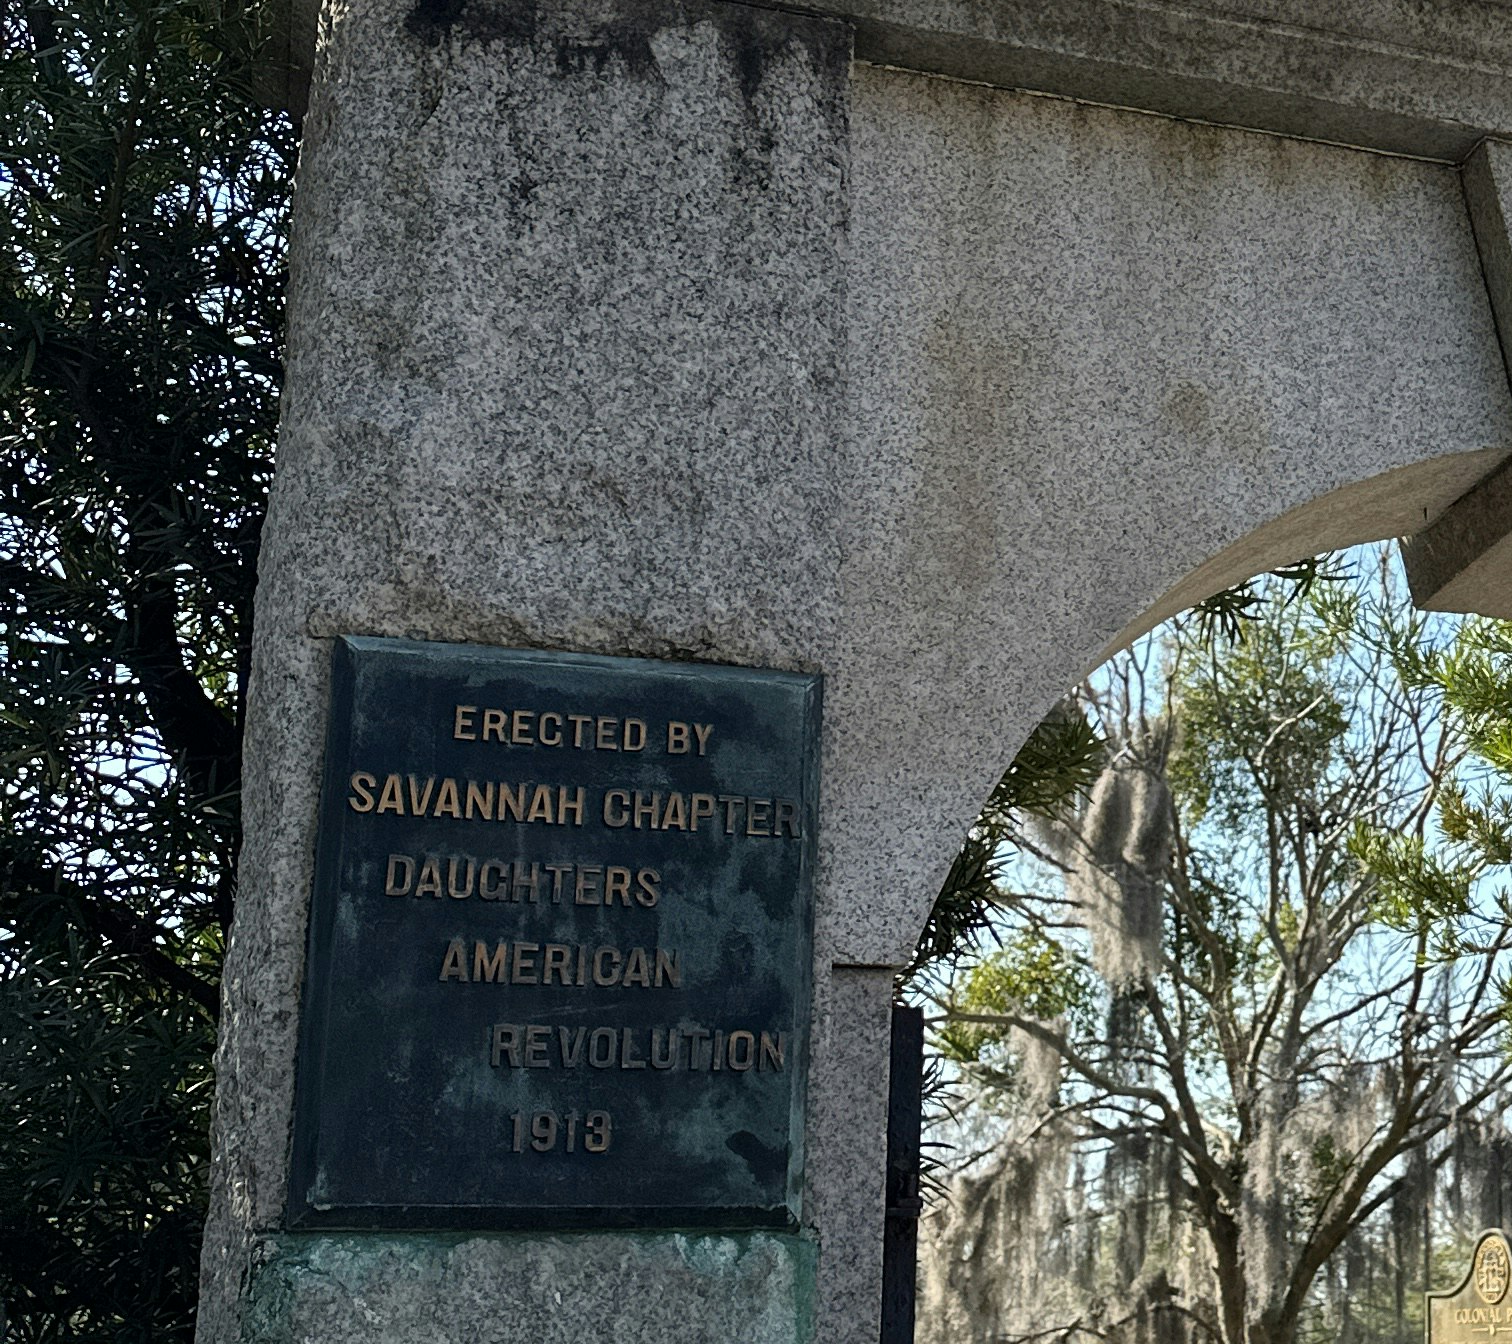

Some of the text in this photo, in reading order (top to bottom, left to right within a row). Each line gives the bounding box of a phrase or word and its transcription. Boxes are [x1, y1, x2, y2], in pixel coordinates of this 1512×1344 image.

[453, 704, 715, 757] ERECTED BY
[347, 769, 802, 840] SAVANNAH CHAPTER
[384, 853, 663, 909] DAUGHTERS
[438, 937, 682, 989] AMERICAN
[490, 1022, 787, 1073] REVOLUTION
[508, 1109, 614, 1155] 1913
[1455, 1306, 1502, 1325] COLONIAL
